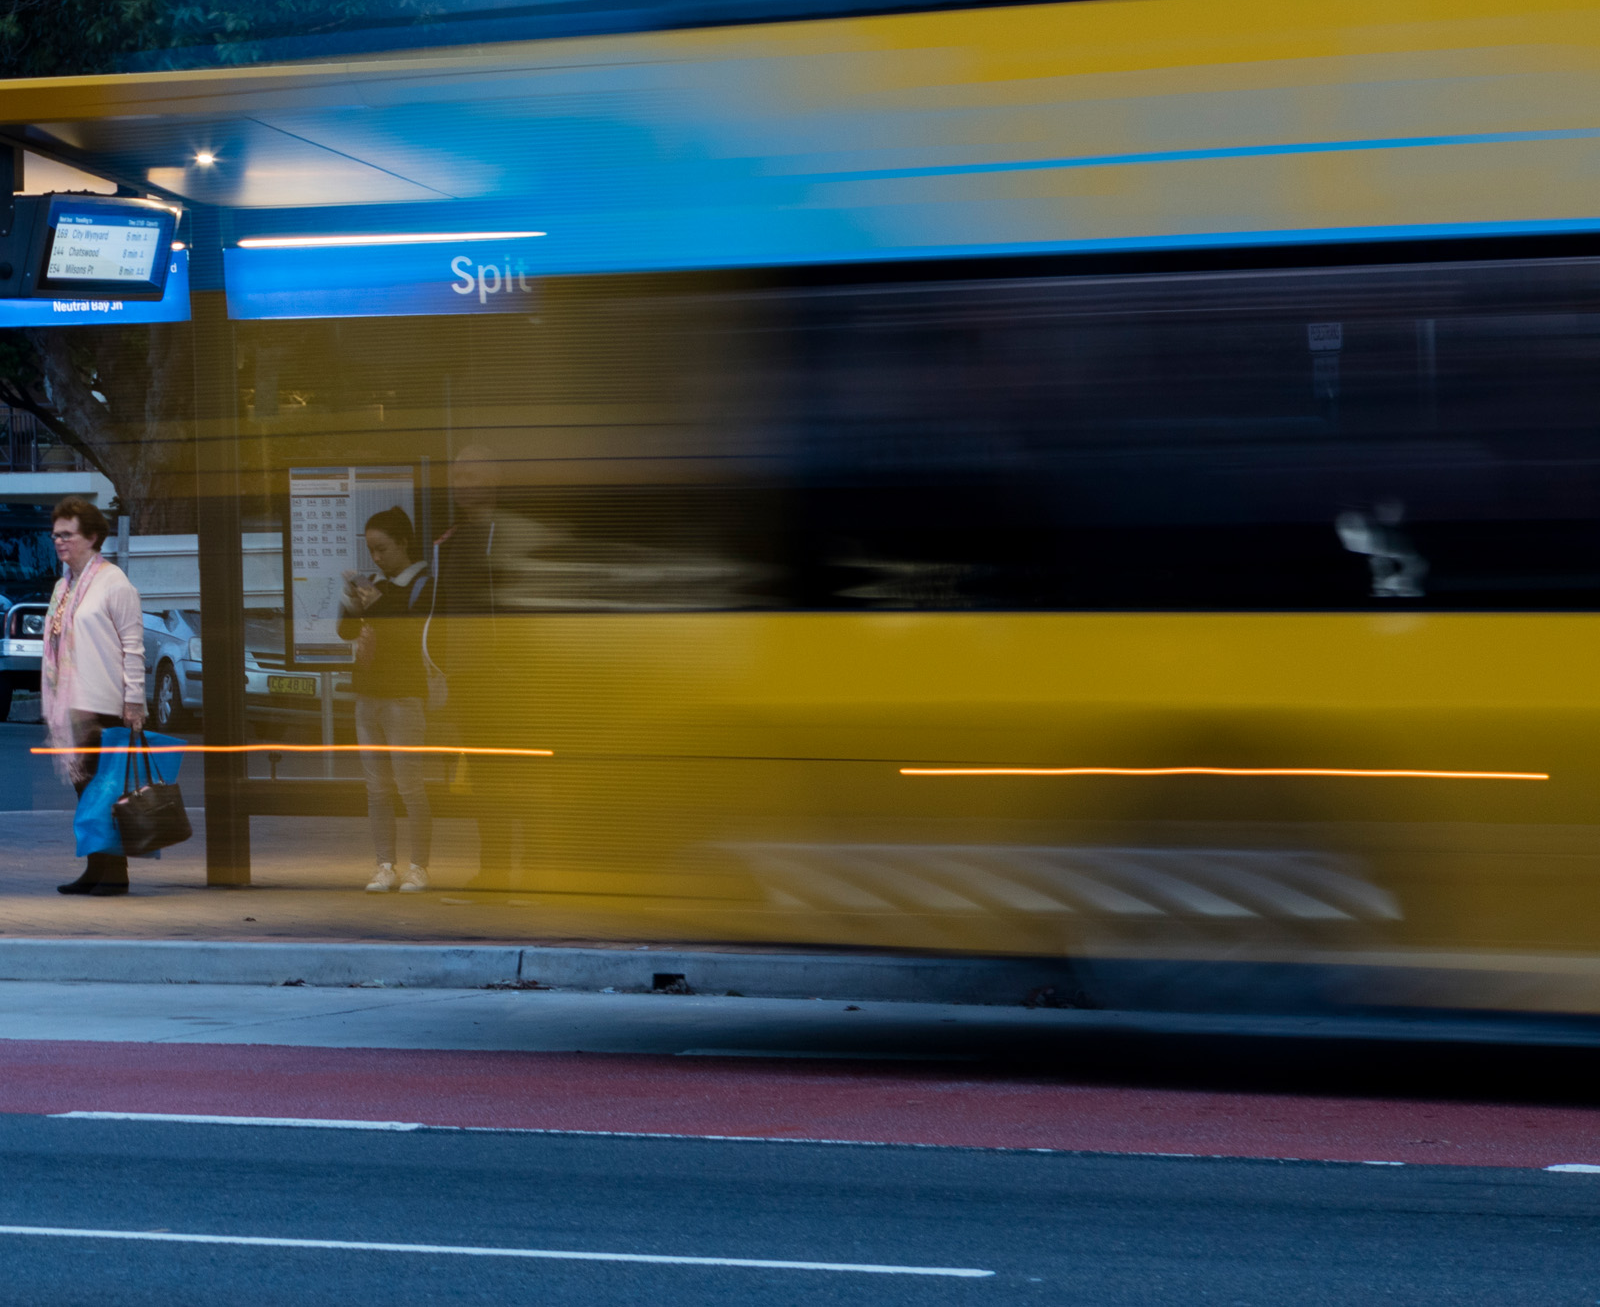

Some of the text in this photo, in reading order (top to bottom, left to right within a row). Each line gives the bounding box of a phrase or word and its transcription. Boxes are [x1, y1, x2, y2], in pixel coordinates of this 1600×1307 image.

[57, 229, 68, 238] 169
[72, 229, 83, 240] City
[84, 230, 109, 242] Wynyard
[131, 232, 142, 241] min
[53, 247, 64, 256] 144
[69, 247, 99, 257] Chatswood
[127, 250, 138, 258] min
[49, 264, 60, 273] E54
[65, 264, 86, 274] Milsons
[87, 265, 94, 274] Pt
[450, 254, 532, 304] Spit
[53, 301, 89, 312] Neutral
[91, 302, 109, 314] Bay
